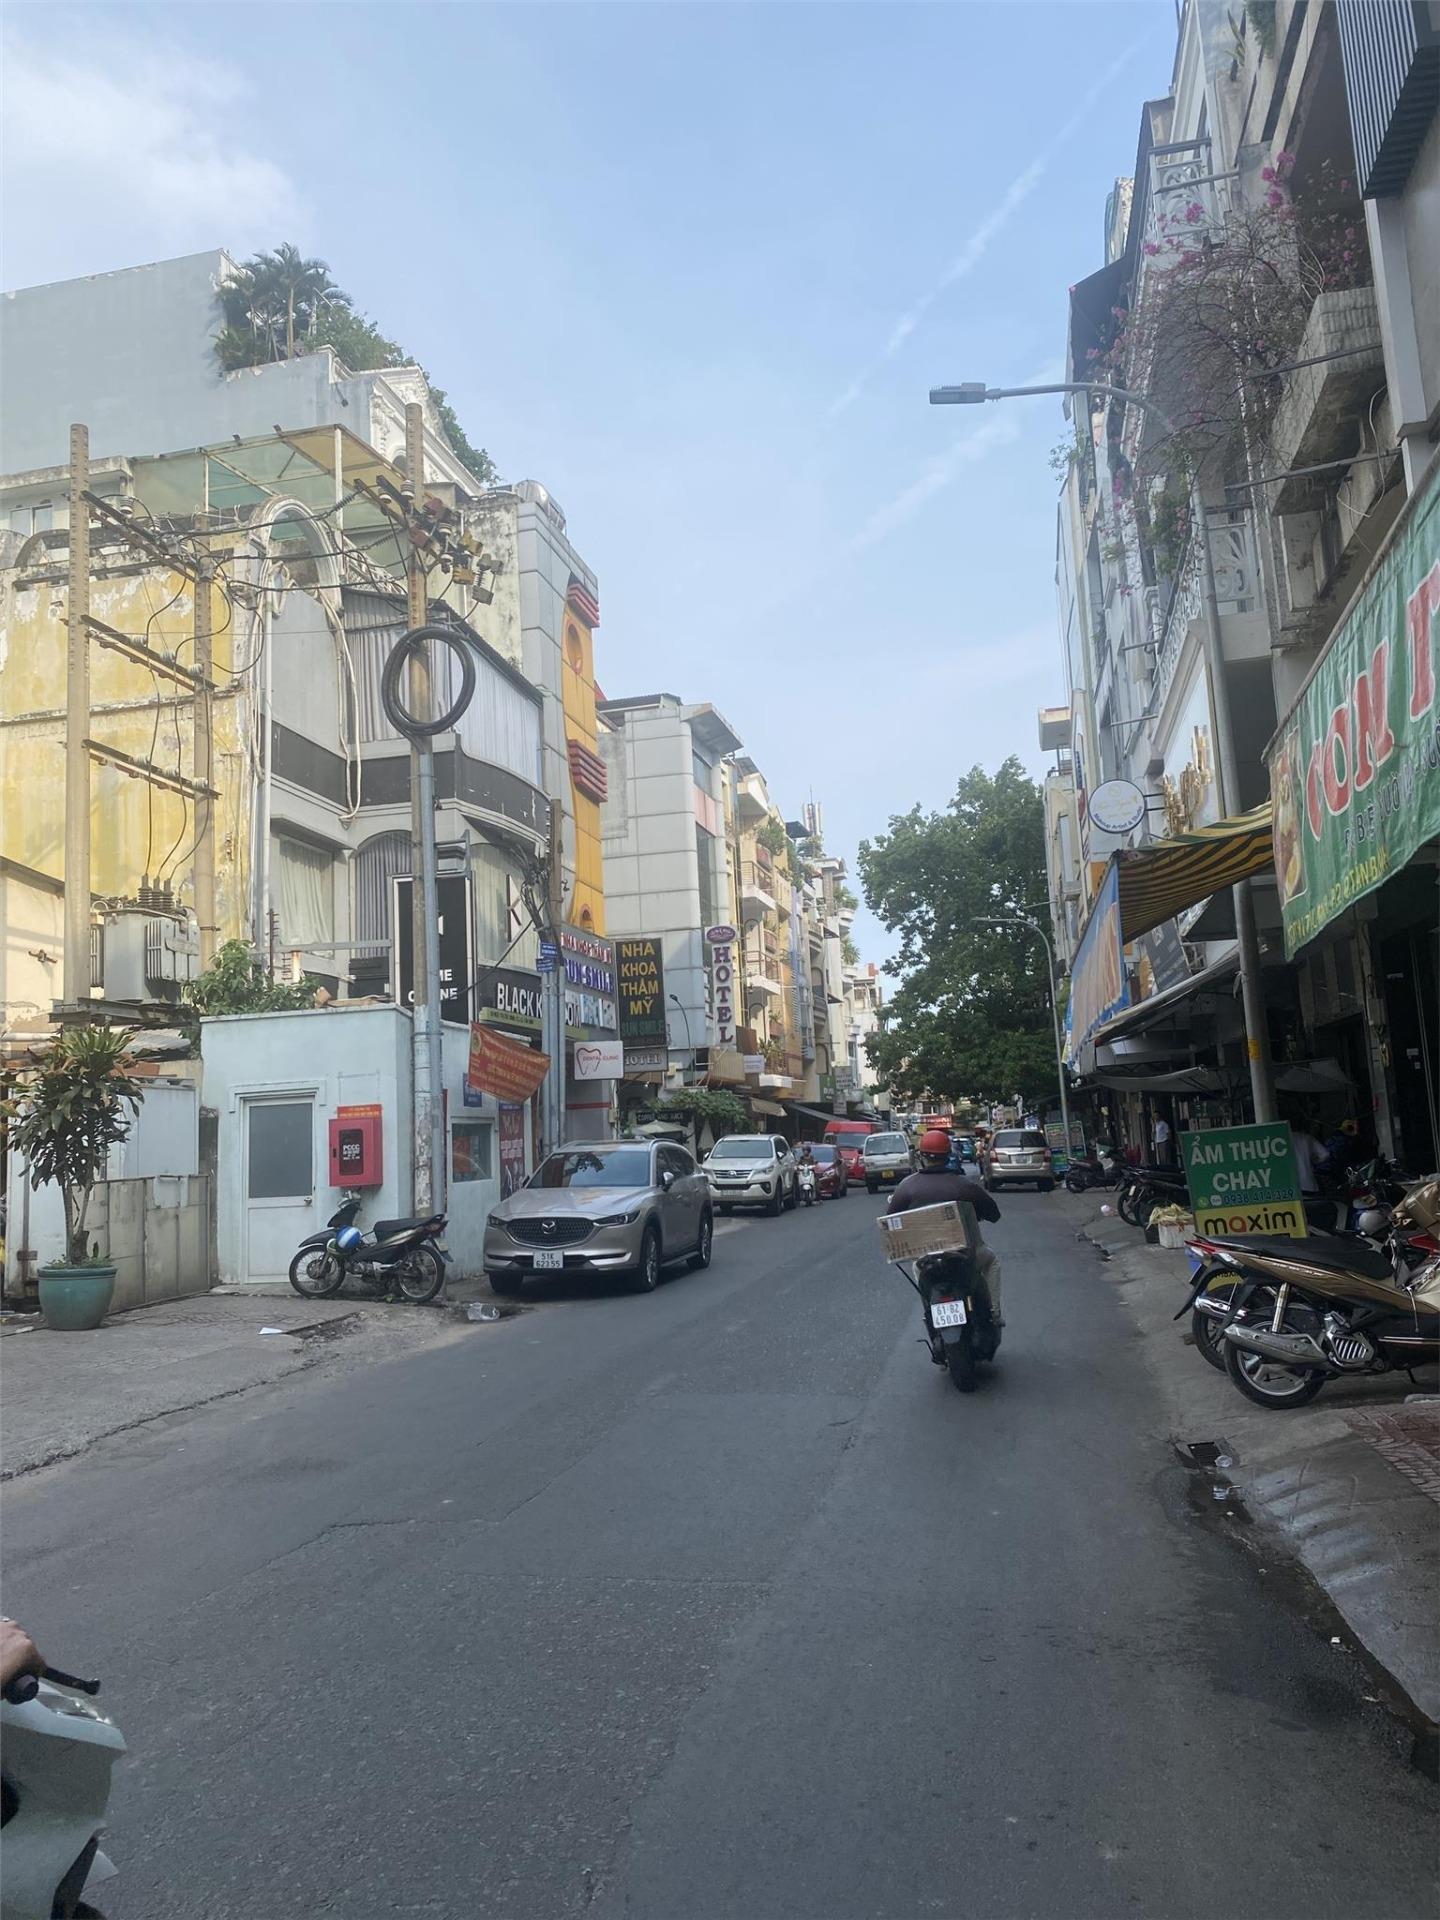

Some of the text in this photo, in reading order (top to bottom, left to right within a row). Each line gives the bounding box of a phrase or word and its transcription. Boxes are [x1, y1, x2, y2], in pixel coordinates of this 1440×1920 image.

[622, 943, 655, 957] NHA
[621, 962, 657, 977] KHOA
[497, 983, 534, 1016] BLACK
[630, 996, 654, 1015] MỸ
[713, 946, 734, 1043] HOTEL
[1191, 1136, 1288, 1166] ẨM THỰC
[1213, 1168, 1271, 1192] CHAY
[1204, 1208, 1296, 1235] maxim
